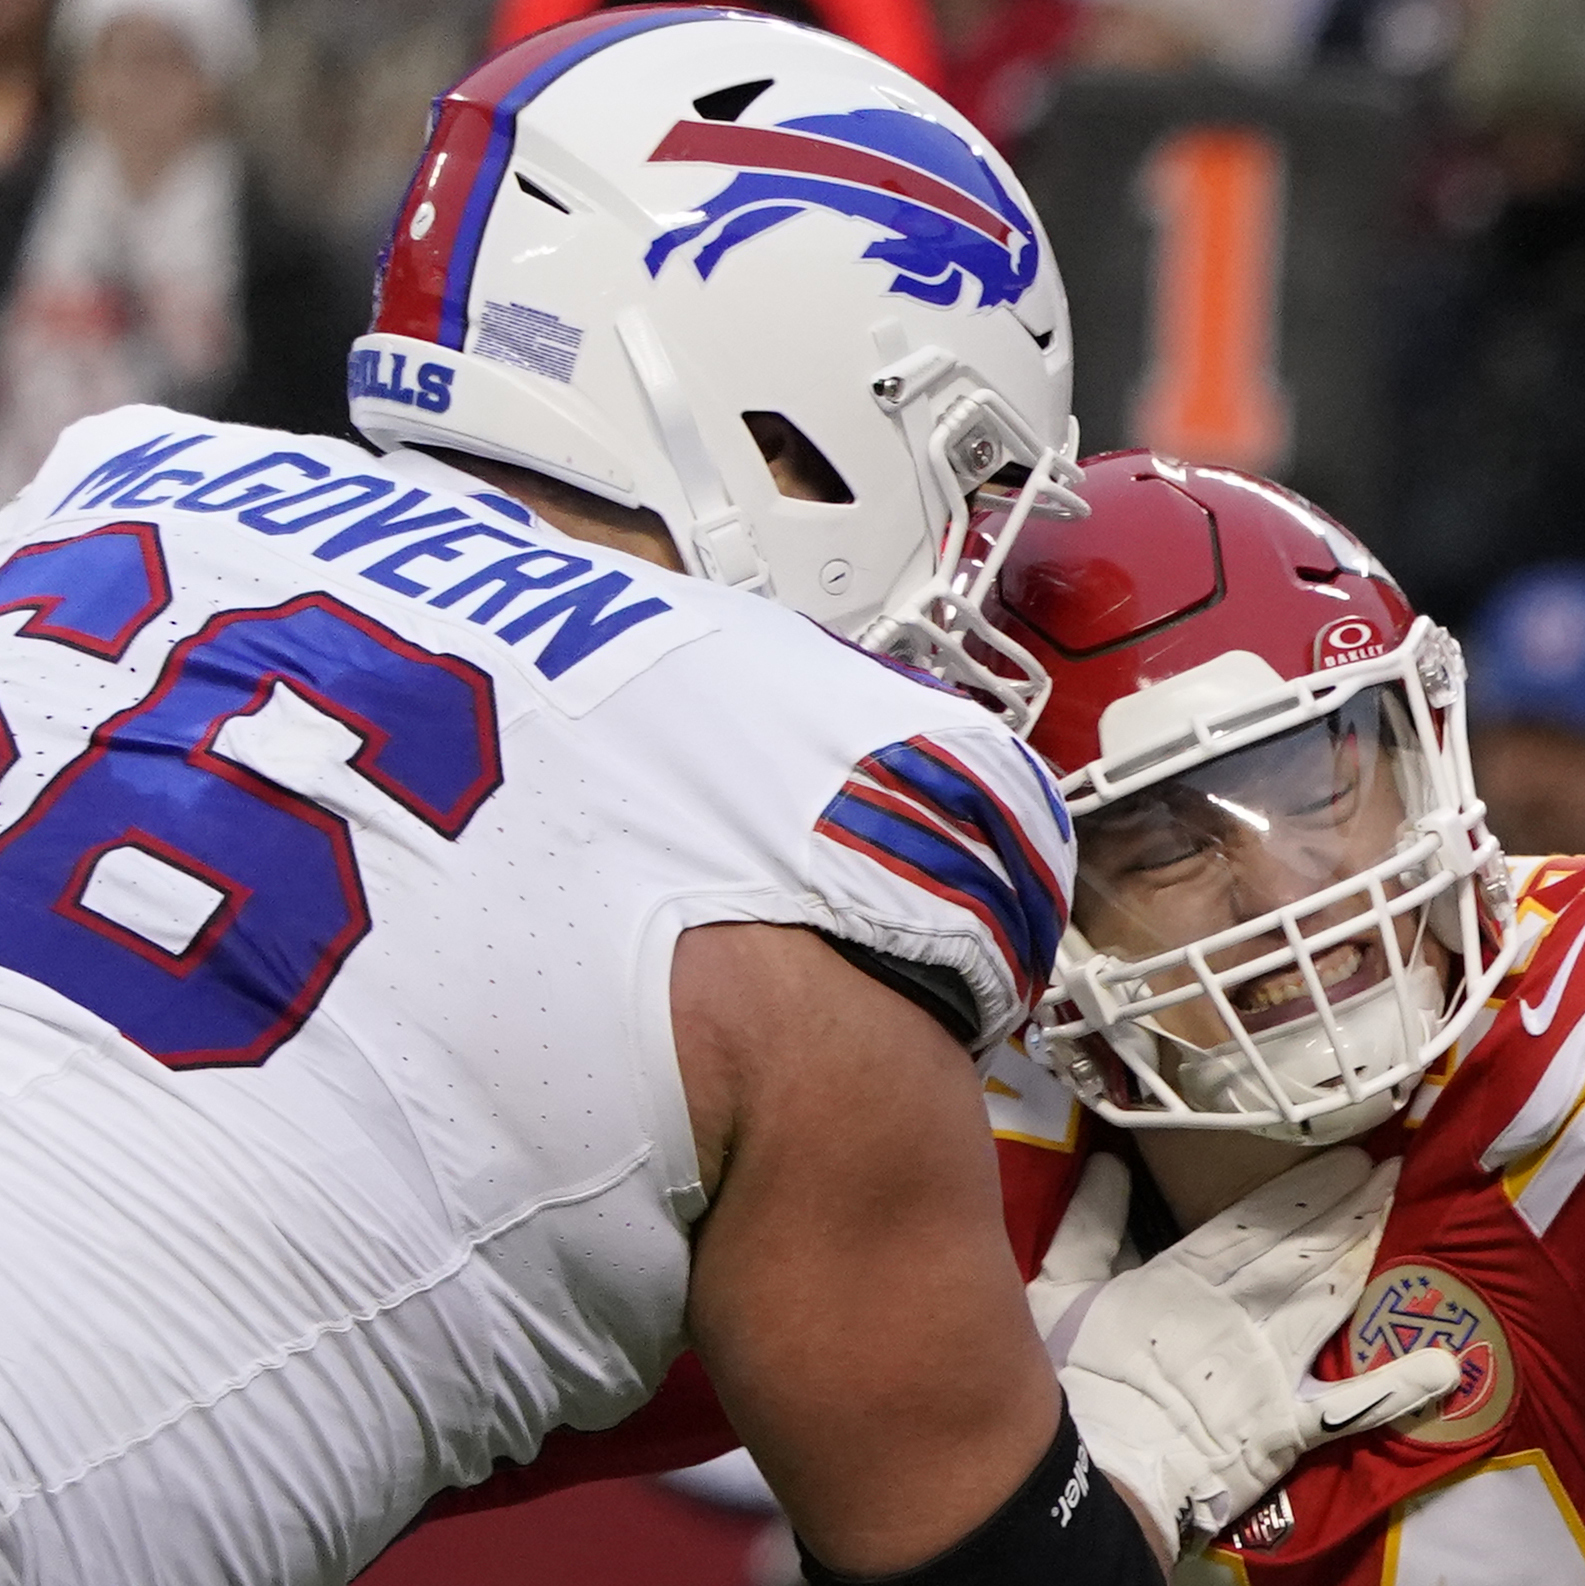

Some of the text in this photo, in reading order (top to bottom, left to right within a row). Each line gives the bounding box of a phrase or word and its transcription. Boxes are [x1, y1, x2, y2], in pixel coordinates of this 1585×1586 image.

[1135, 125, 1292, 468] 1
[50, 432, 673, 681] McGOVERN
[1324, 643, 1384, 668] OAKLEY
[1060, 1442, 1090, 1528] eller
